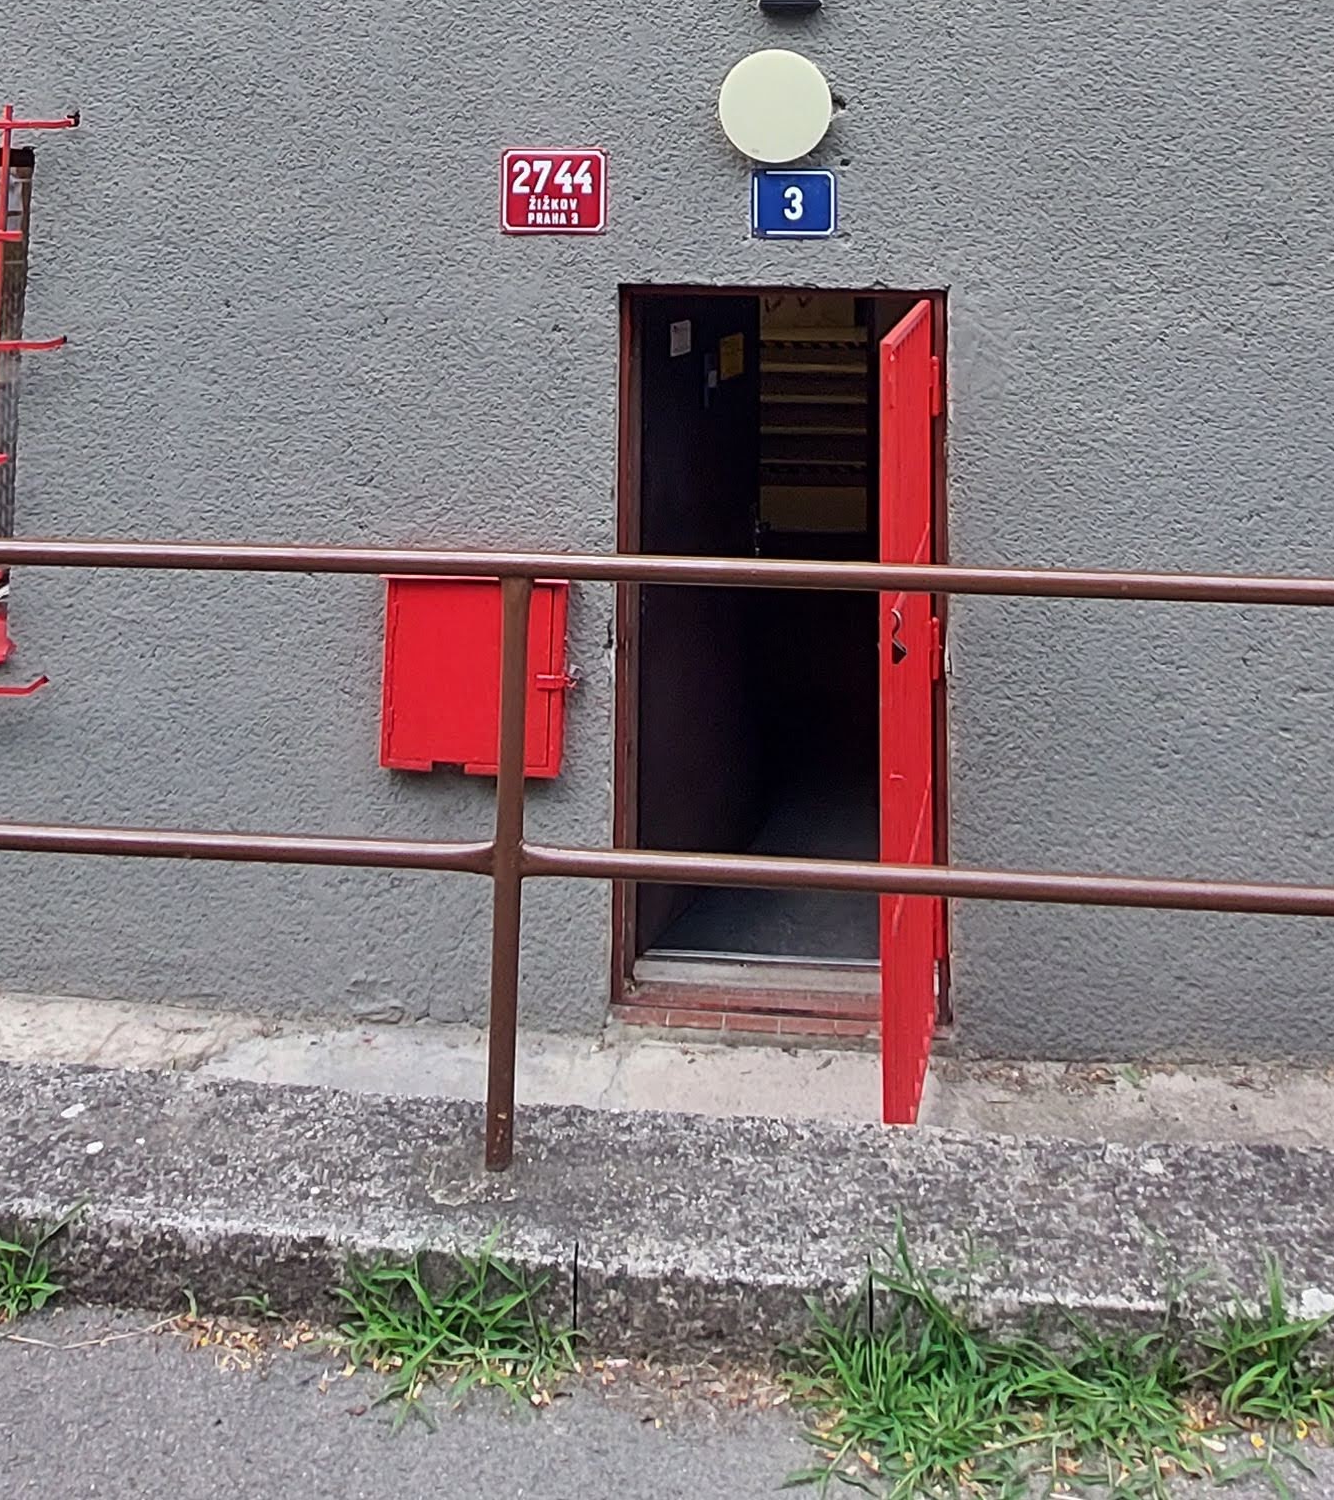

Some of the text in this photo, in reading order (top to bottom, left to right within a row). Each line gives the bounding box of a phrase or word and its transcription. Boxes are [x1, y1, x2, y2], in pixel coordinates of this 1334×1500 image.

[512, 160, 593, 194] 2744
[528, 194, 578, 211] ŽIŽKOV
[783, 186, 804, 221] 3
[527, 212, 579, 225] PRAHA 3
